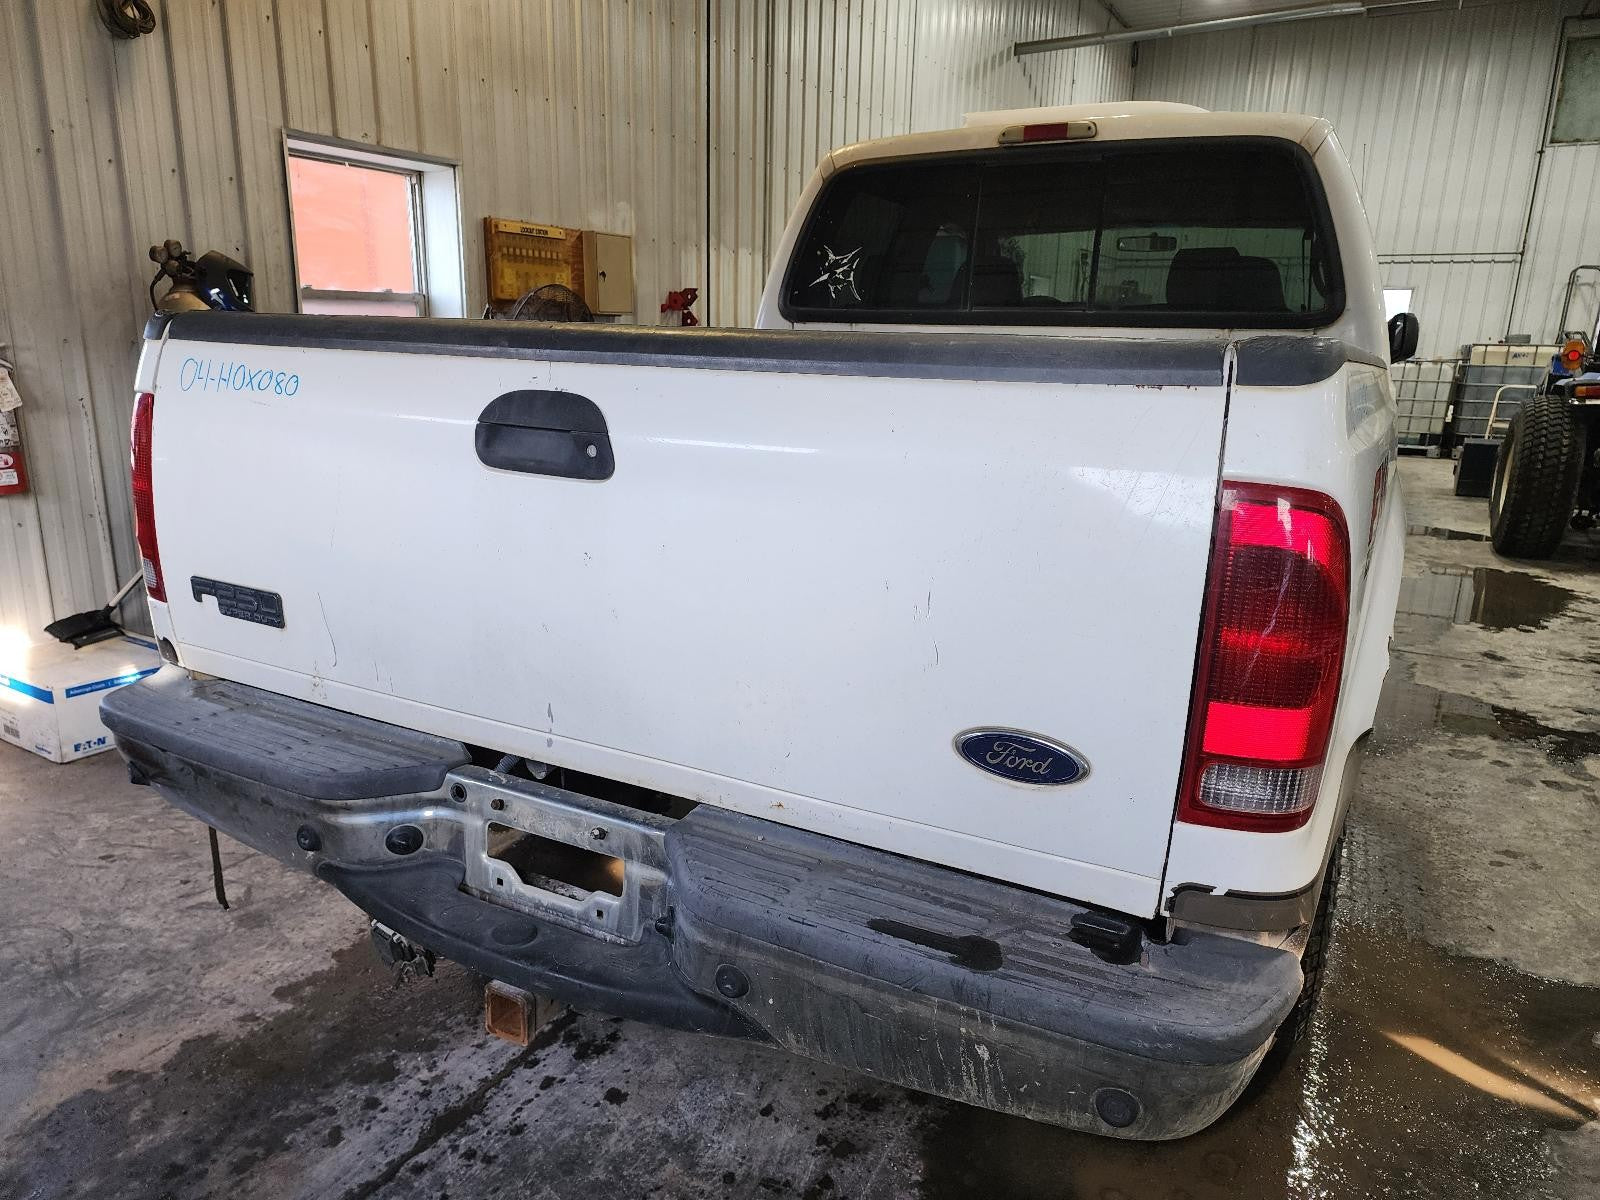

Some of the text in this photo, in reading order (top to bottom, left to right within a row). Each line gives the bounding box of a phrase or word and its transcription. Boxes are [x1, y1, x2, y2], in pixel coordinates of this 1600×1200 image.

[220, 606, 282, 627] SUPER DUTY
[985, 741, 1051, 775] Ford
